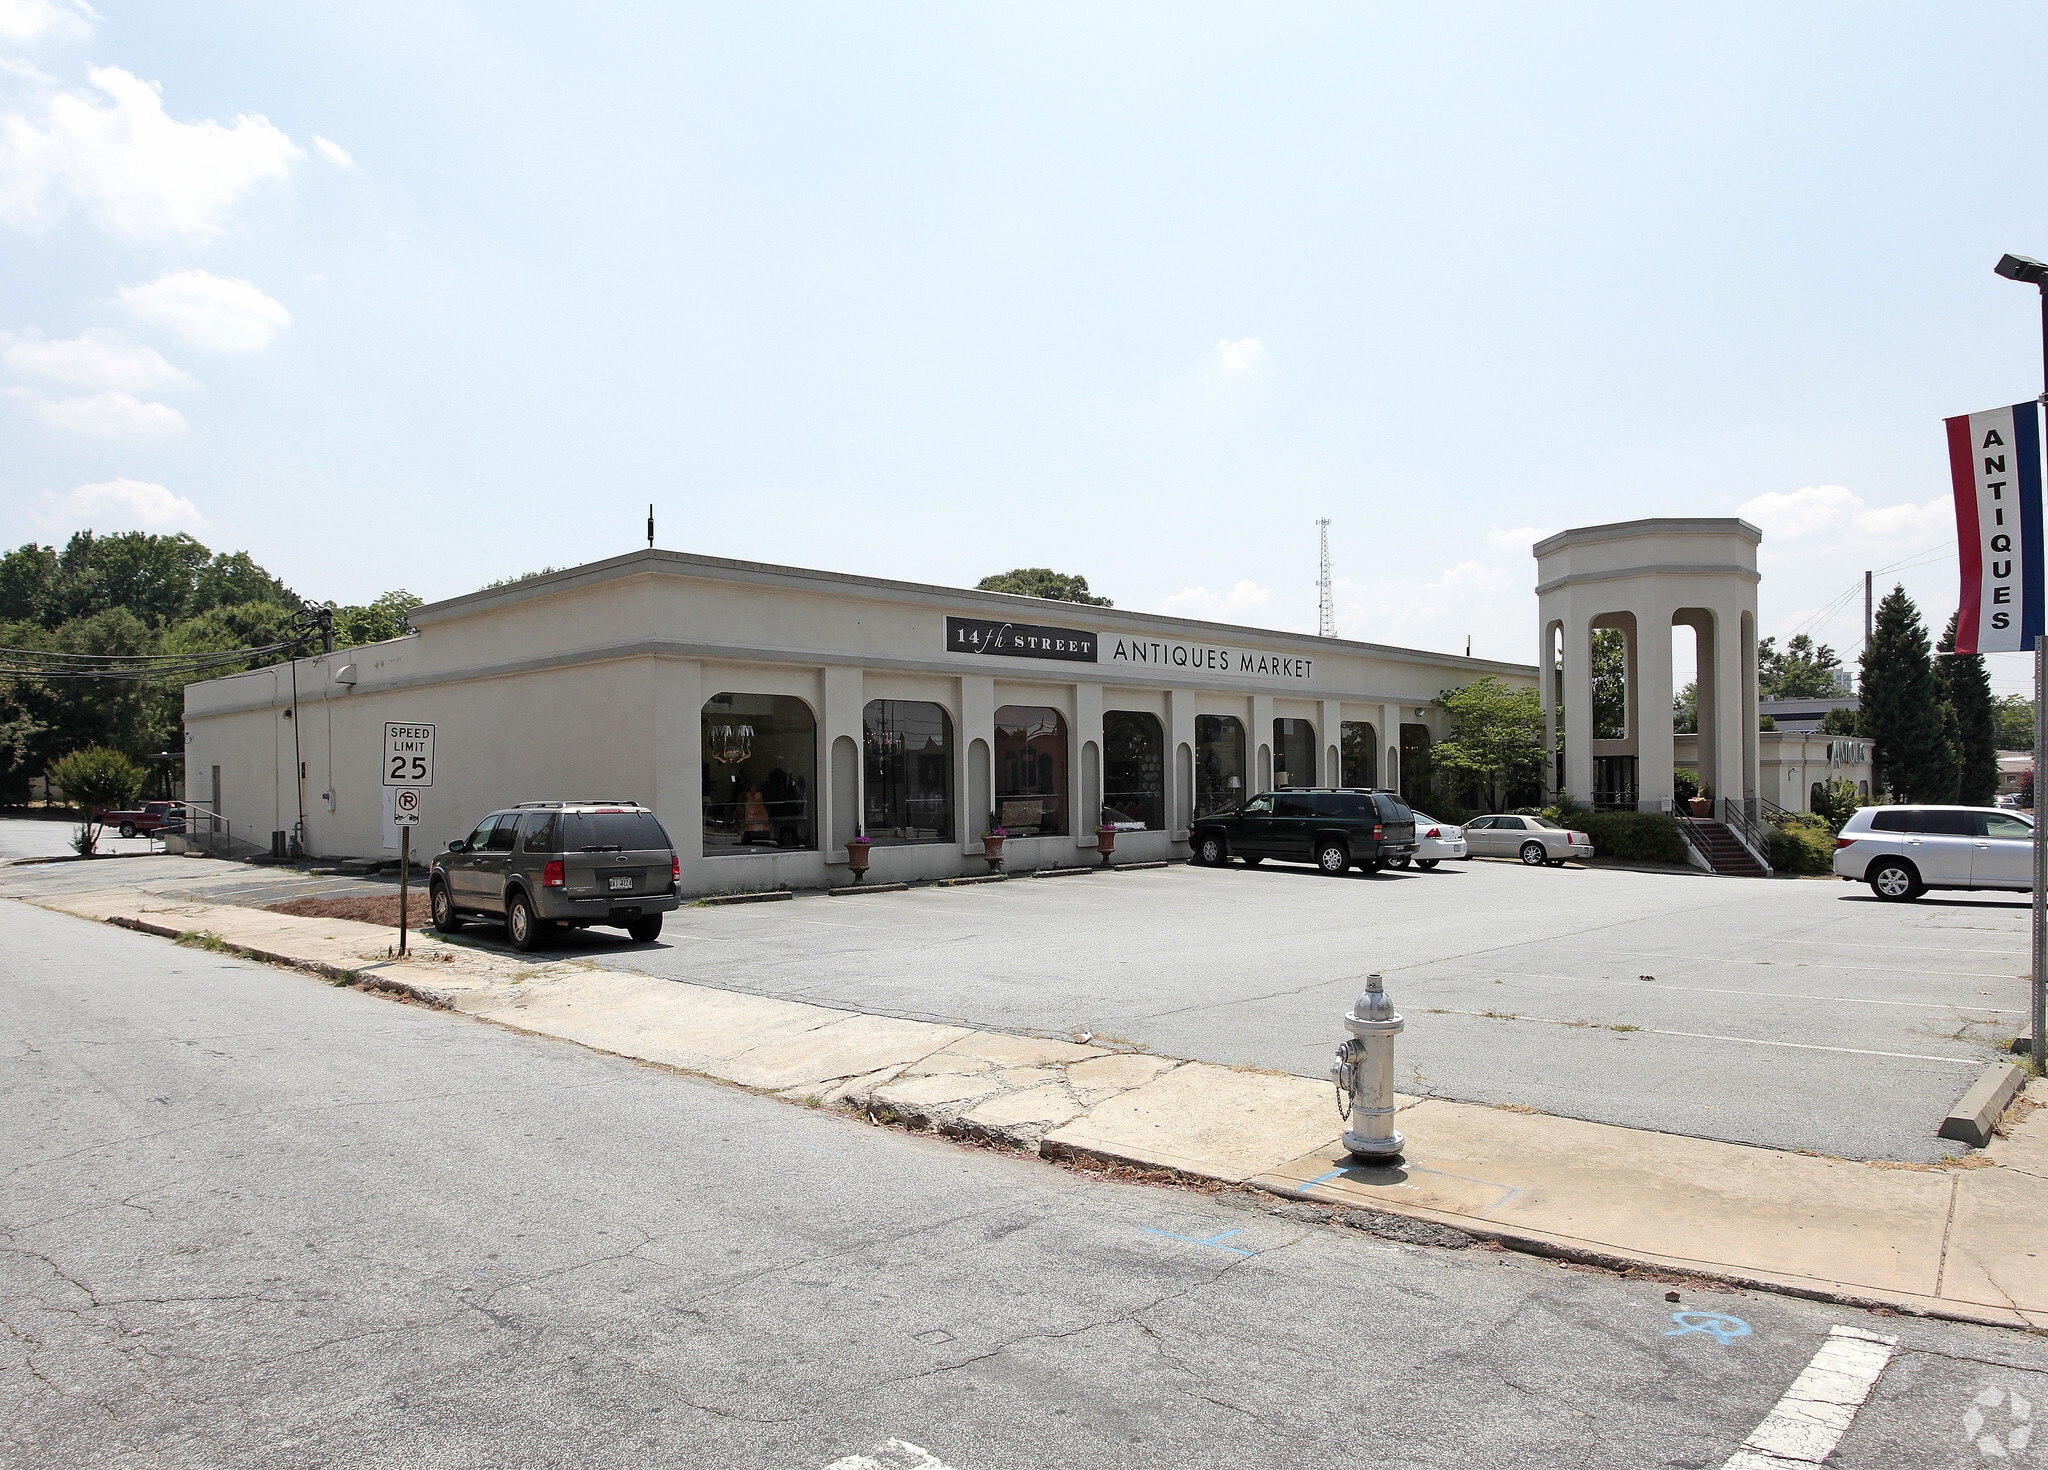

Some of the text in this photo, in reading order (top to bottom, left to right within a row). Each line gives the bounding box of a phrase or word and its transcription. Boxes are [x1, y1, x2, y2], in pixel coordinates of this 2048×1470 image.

[1982, 429, 2012, 630] ANTIQUES
[957, 623, 1091, 654] 14th STREET
[1113, 638, 1312, 679] ANTIQUES MARKET
[390, 727, 430, 739] SPEED
[394, 741, 425, 752] LIMIT
[390, 756, 427, 780] 25
